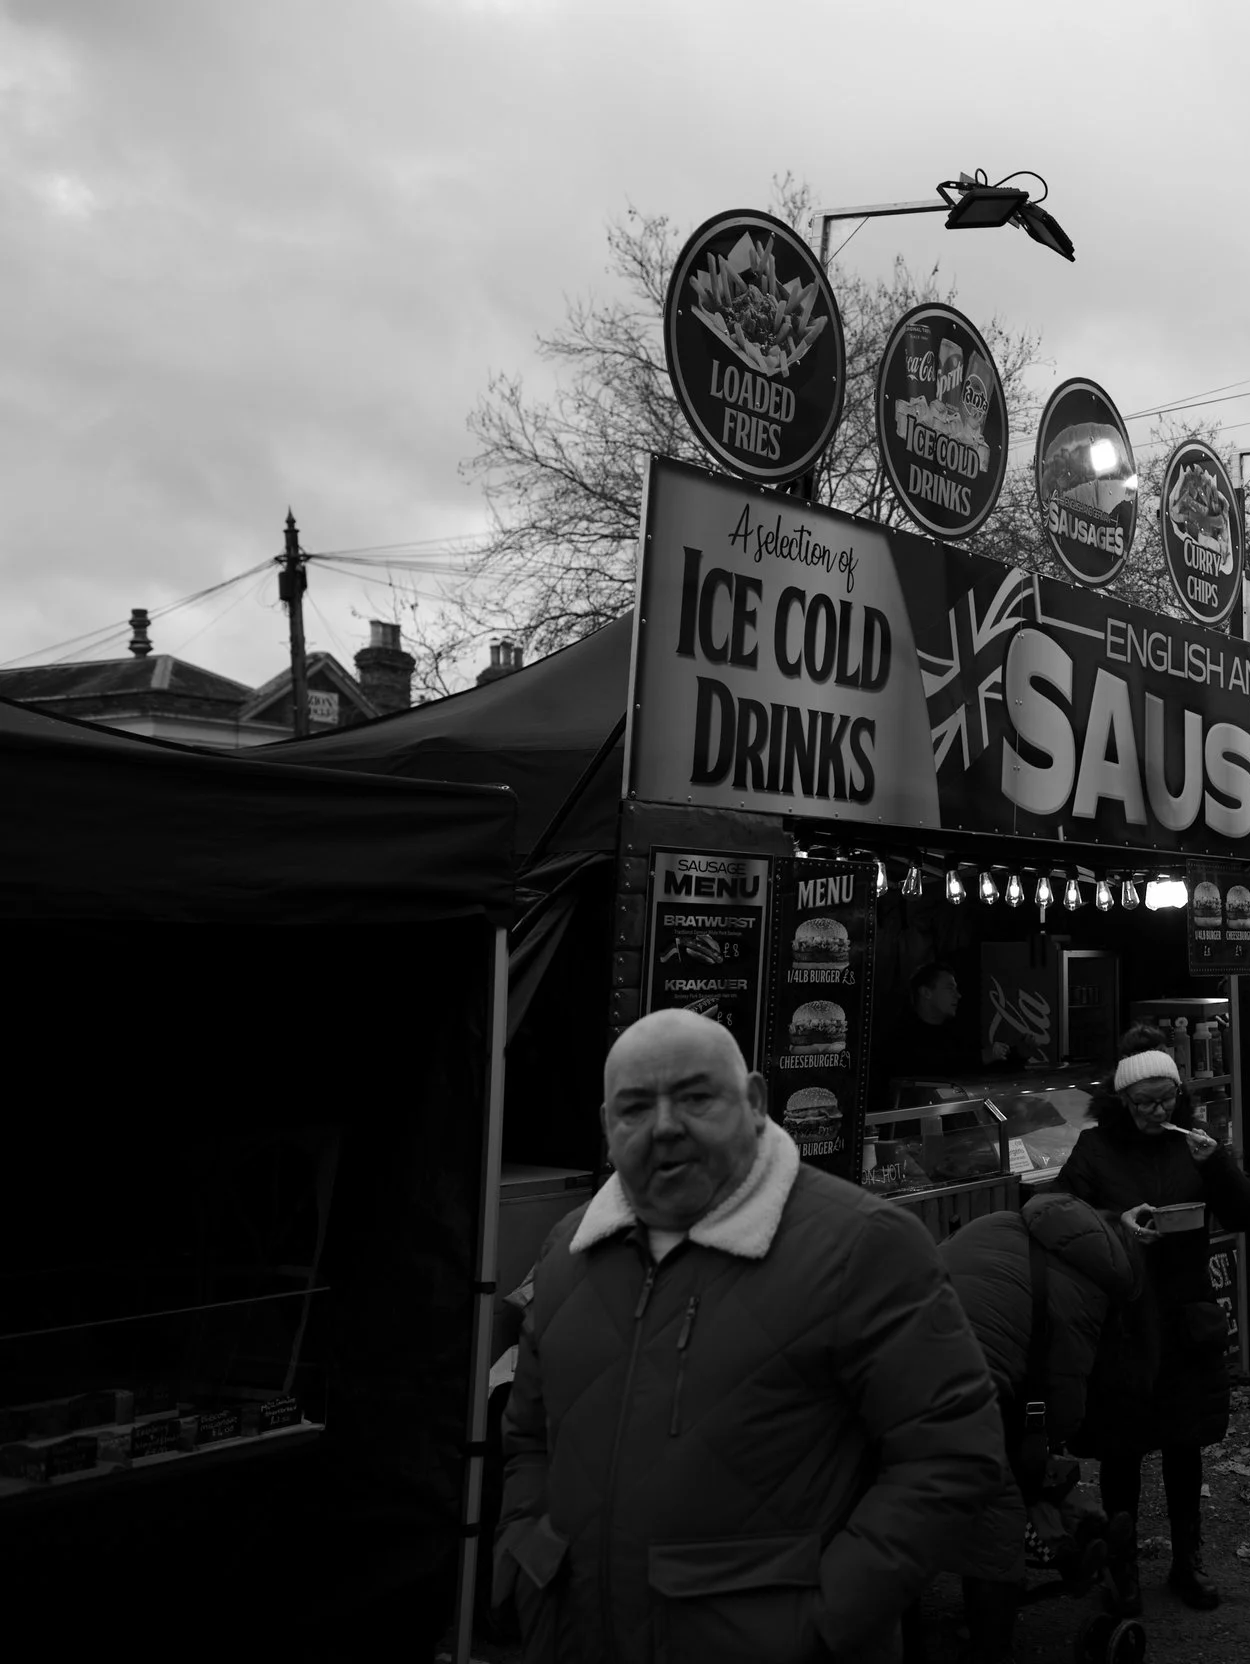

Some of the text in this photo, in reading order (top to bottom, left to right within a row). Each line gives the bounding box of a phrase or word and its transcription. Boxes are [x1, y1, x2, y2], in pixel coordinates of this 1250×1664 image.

[710, 359, 796, 424] LOADED
[962, 379, 989, 412] Fanta
[722, 407, 783, 461] FRIES
[906, 414, 979, 480] ICE COLD
[909, 463, 971, 516] DRINKS
[1048, 501, 1124, 556] SAUSAGES
[728, 503, 860, 593] A selection of
[1183, 537, 1222, 577] CURRY
[1187, 575, 1219, 609] CHIPS
[676, 546, 892, 692] ICE COLD
[1105, 618, 1227, 690] ENGLISH
[690, 676, 876, 804] DRINKS
[664, 870, 760, 898] MENU
[678, 859, 746, 875] SAUSAGE
[797, 874, 855, 911] MENU
[663, 914, 756, 929] BRATWURST
[723, 942, 740, 958] £8
[664, 978, 748, 991] KRAKAUER
[787, 967, 856, 986] 1/4LB BURGER £8
[717, 1011, 733, 1026] £8
[779, 1050, 851, 1070] CHEESEBURGER £9
[802, 1141, 834, 1157] BURGER
[880, 1159, 907, 1184] HOT!
